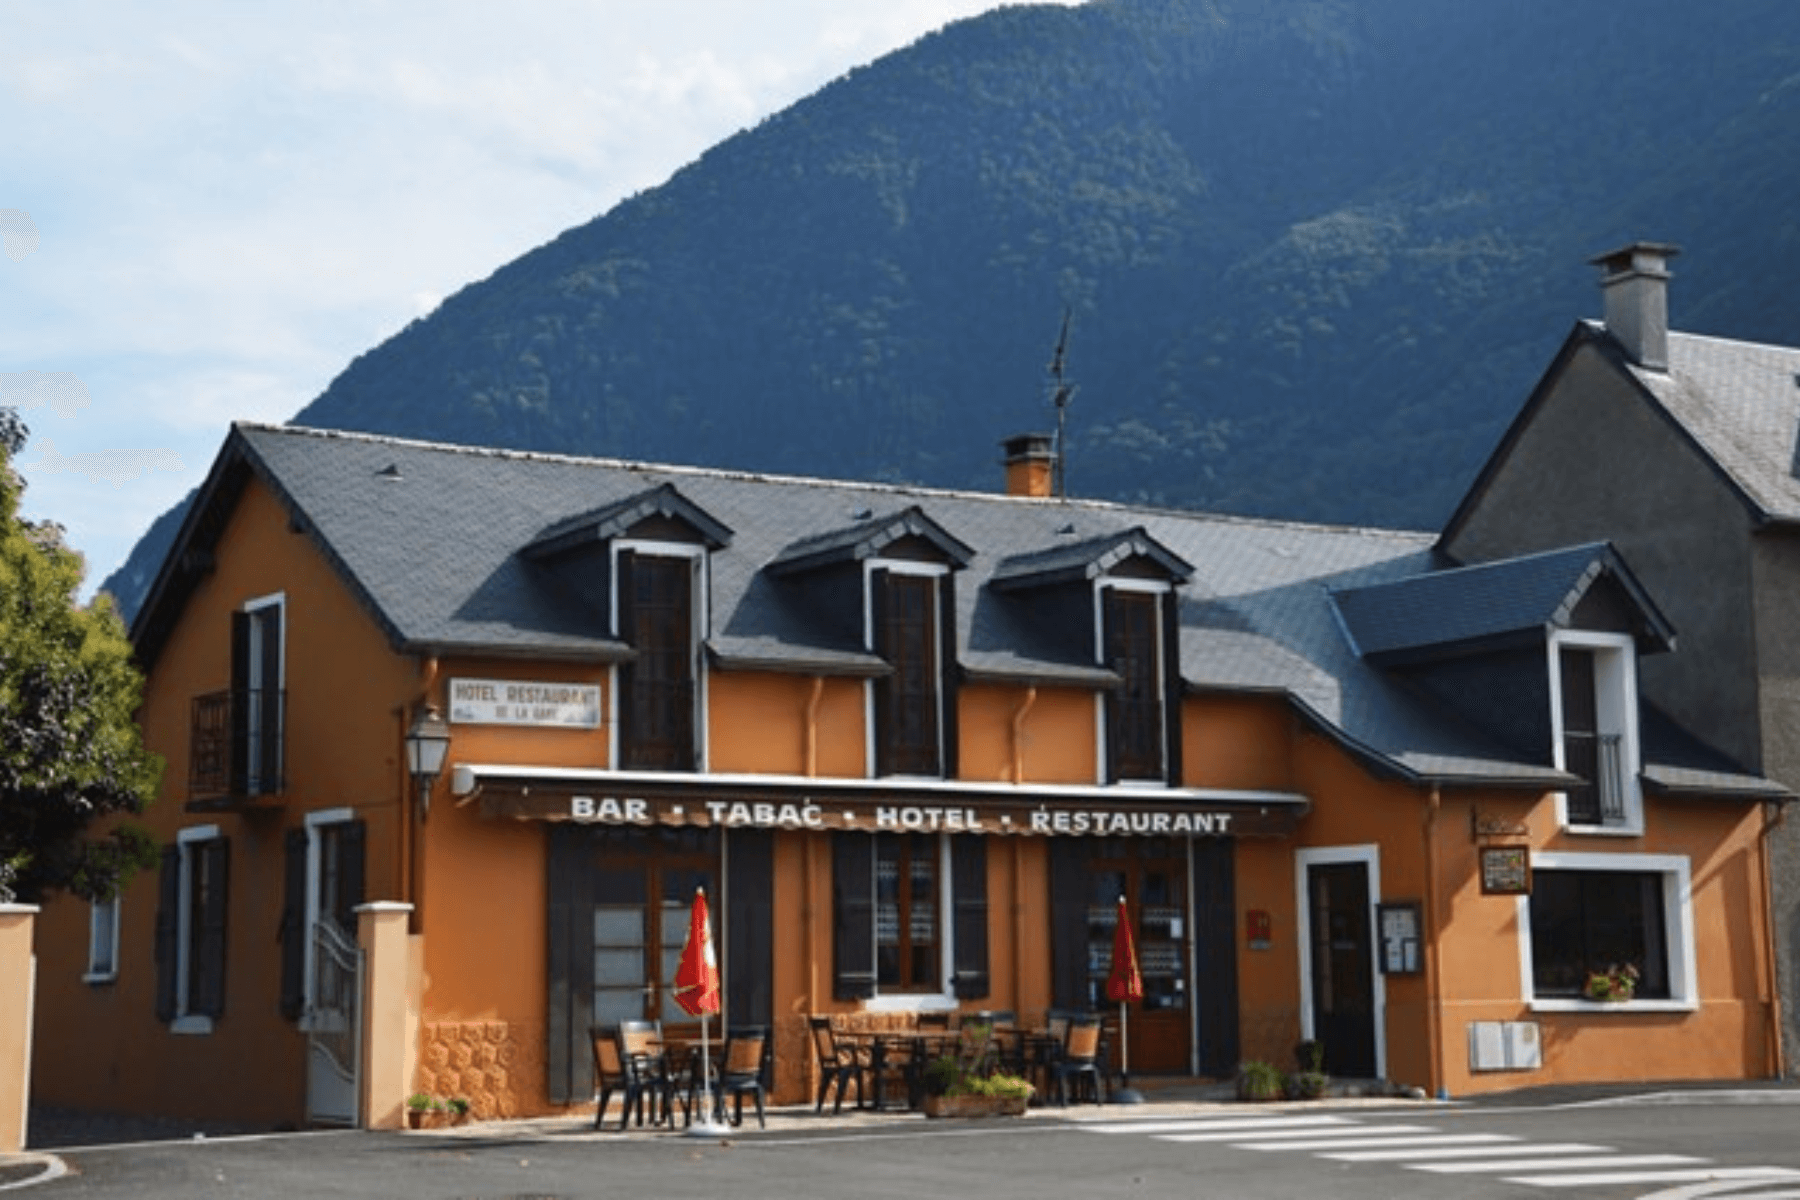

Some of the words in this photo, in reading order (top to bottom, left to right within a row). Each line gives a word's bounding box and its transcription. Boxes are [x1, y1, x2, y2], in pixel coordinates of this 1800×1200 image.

[456, 682, 497, 702] HOTEL
[506, 685, 596, 706] RESTAURANT
[571, 796, 648, 824] BAR
[705, 801, 822, 829] TABAC
[875, 806, 983, 832] HOTEL
[1030, 811, 1232, 836] RESTAURANT
